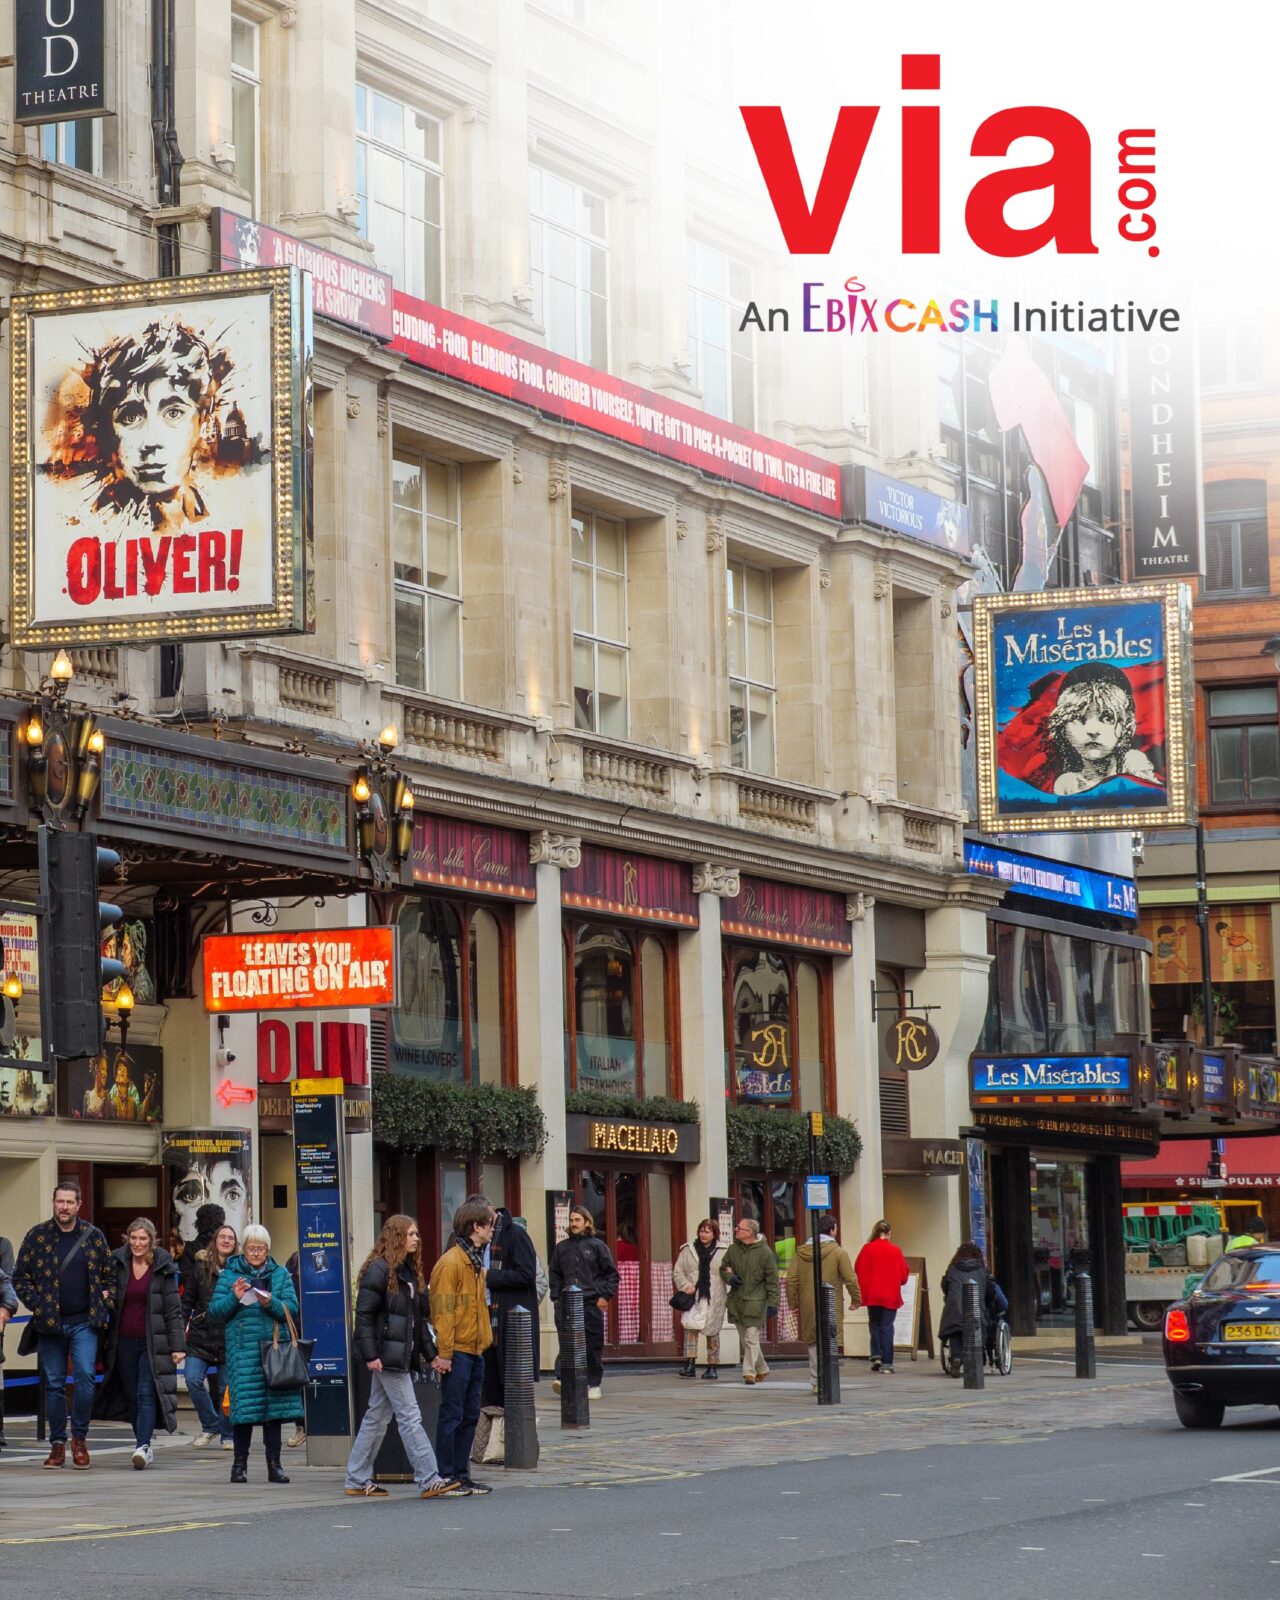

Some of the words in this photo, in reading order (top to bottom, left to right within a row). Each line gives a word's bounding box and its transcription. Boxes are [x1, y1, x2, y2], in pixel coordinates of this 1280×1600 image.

[22, 83, 99, 106] THEATRE
[340, 261, 387, 306] DICKENS
[392, 309, 436, 349] CLUDING
[442, 328, 471, 364] FOOD,
[472, 340, 519, 380] GLORIOUS
[519, 358, 546, 393] FOOD,
[546, 369, 591, 408] CONSIDER
[591, 386, 635, 427] YOURSELF,
[664, 414, 681, 442] GOT
[682, 422, 693, 447] TO
[693, 426, 753, 470] PICK-A-POCKET
[752, 449, 764, 473] OR
[764, 454, 785, 484] TWO,
[805, 469, 822, 496] FINE
[821, 475, 837, 502] LIFE
[1147, 342, 1179, 548] ONDHEIM
[886, 486, 914, 511] VICTOR
[879, 500, 924, 530] VICTORIOUS
[65, 529, 244, 606] OLIVER!
[1141, 554, 1190, 567] THEATRE
[1057, 616, 1093, 641] Les
[1004, 627, 1153, 667] Misérables
[313, 941, 351, 966] YOU
[211, 965, 310, 999] FLOATING
[313, 962, 344, 991] ON
[257, 1018, 369, 1086] OLIV
[395, 1048, 419, 1065] WINE
[422, 1051, 459, 1068] LOVERS
[590, 1056, 621, 1072] ITALIAN
[580, 1078, 633, 1094] STEAKHOUSE
[986, 1064, 1019, 1087] Les
[1024, 1064, 1121, 1087] Misérables
[592, 1122, 678, 1154] MACELLAIO
[303, 1241, 322, 1249] coming
[308, 1231, 321, 1239] New
[322, 1231, 335, 1240] map
[1227, 1326, 1252, 1338] 236
